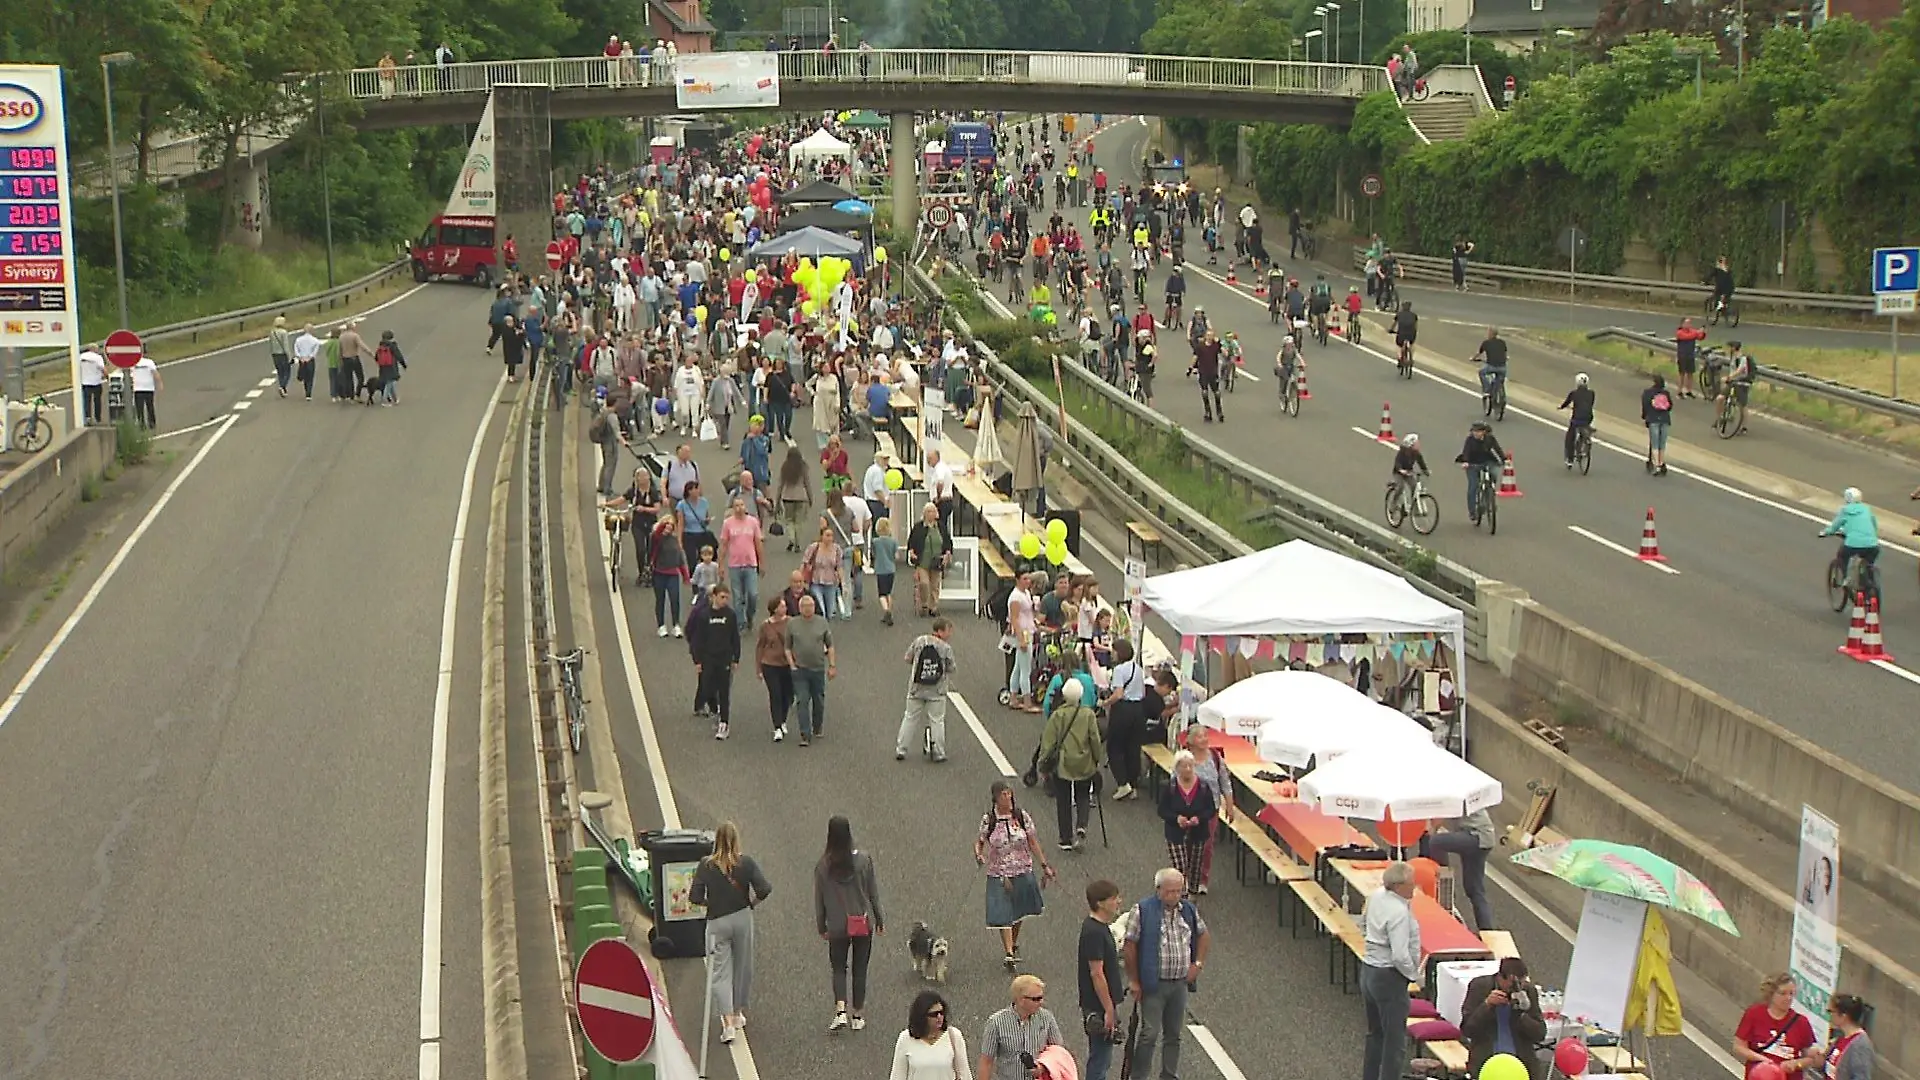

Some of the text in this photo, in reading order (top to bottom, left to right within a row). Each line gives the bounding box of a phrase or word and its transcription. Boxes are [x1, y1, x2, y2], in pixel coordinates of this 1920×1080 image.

[959, 132, 978, 140] THW
[932, 209, 948, 219] 100
[4, 264, 58, 280] Synergy
[1884, 253, 1909, 287] P
[1335, 798, 1360, 811] ccp
